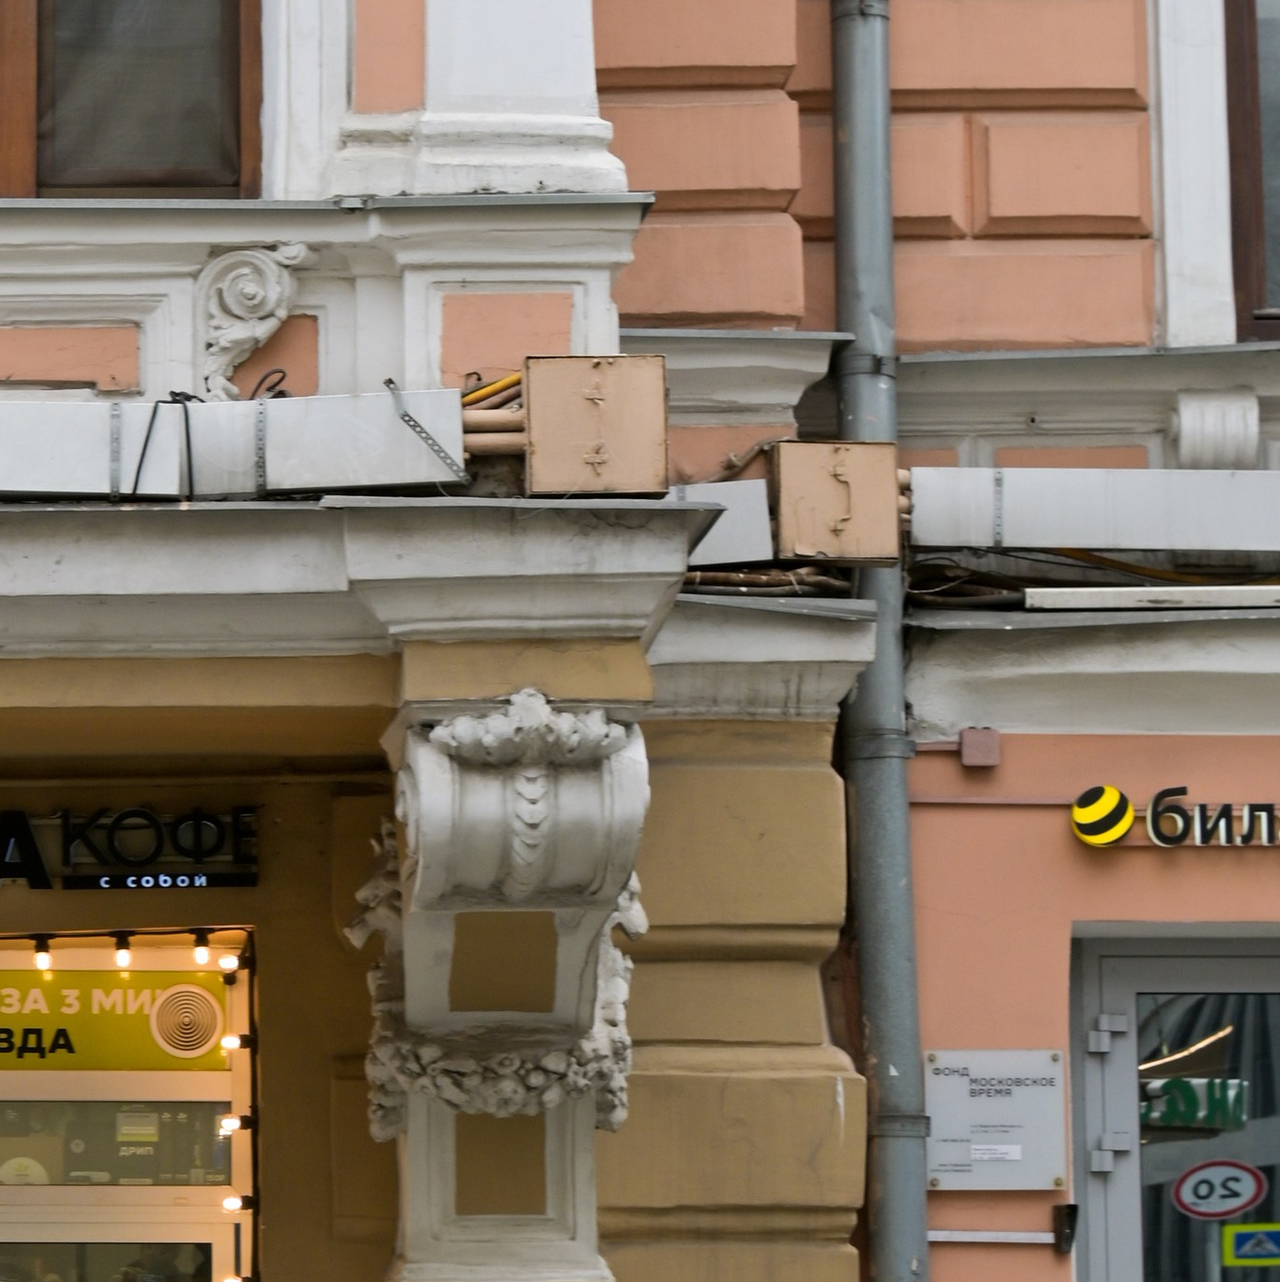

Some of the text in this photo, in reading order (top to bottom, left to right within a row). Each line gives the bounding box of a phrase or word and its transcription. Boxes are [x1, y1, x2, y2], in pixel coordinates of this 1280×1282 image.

[1147, 786, 1280, 847] бил
[61, 806, 258, 866] КОФЕ
[99, 873, 208, 888] с собой
[0, 988, 50, 1015] ЗА
[60, 989, 80, 1015] 3
[91, 989, 161, 1015] МИ
[932, 1067, 969, 1077] ФОНД
[969, 1077, 1056, 1087] МОСКОВСКОЕ
[969, 1088, 1012, 1097] ВРЕМЯ
[119, 1146, 154, 1157] ДРИП
